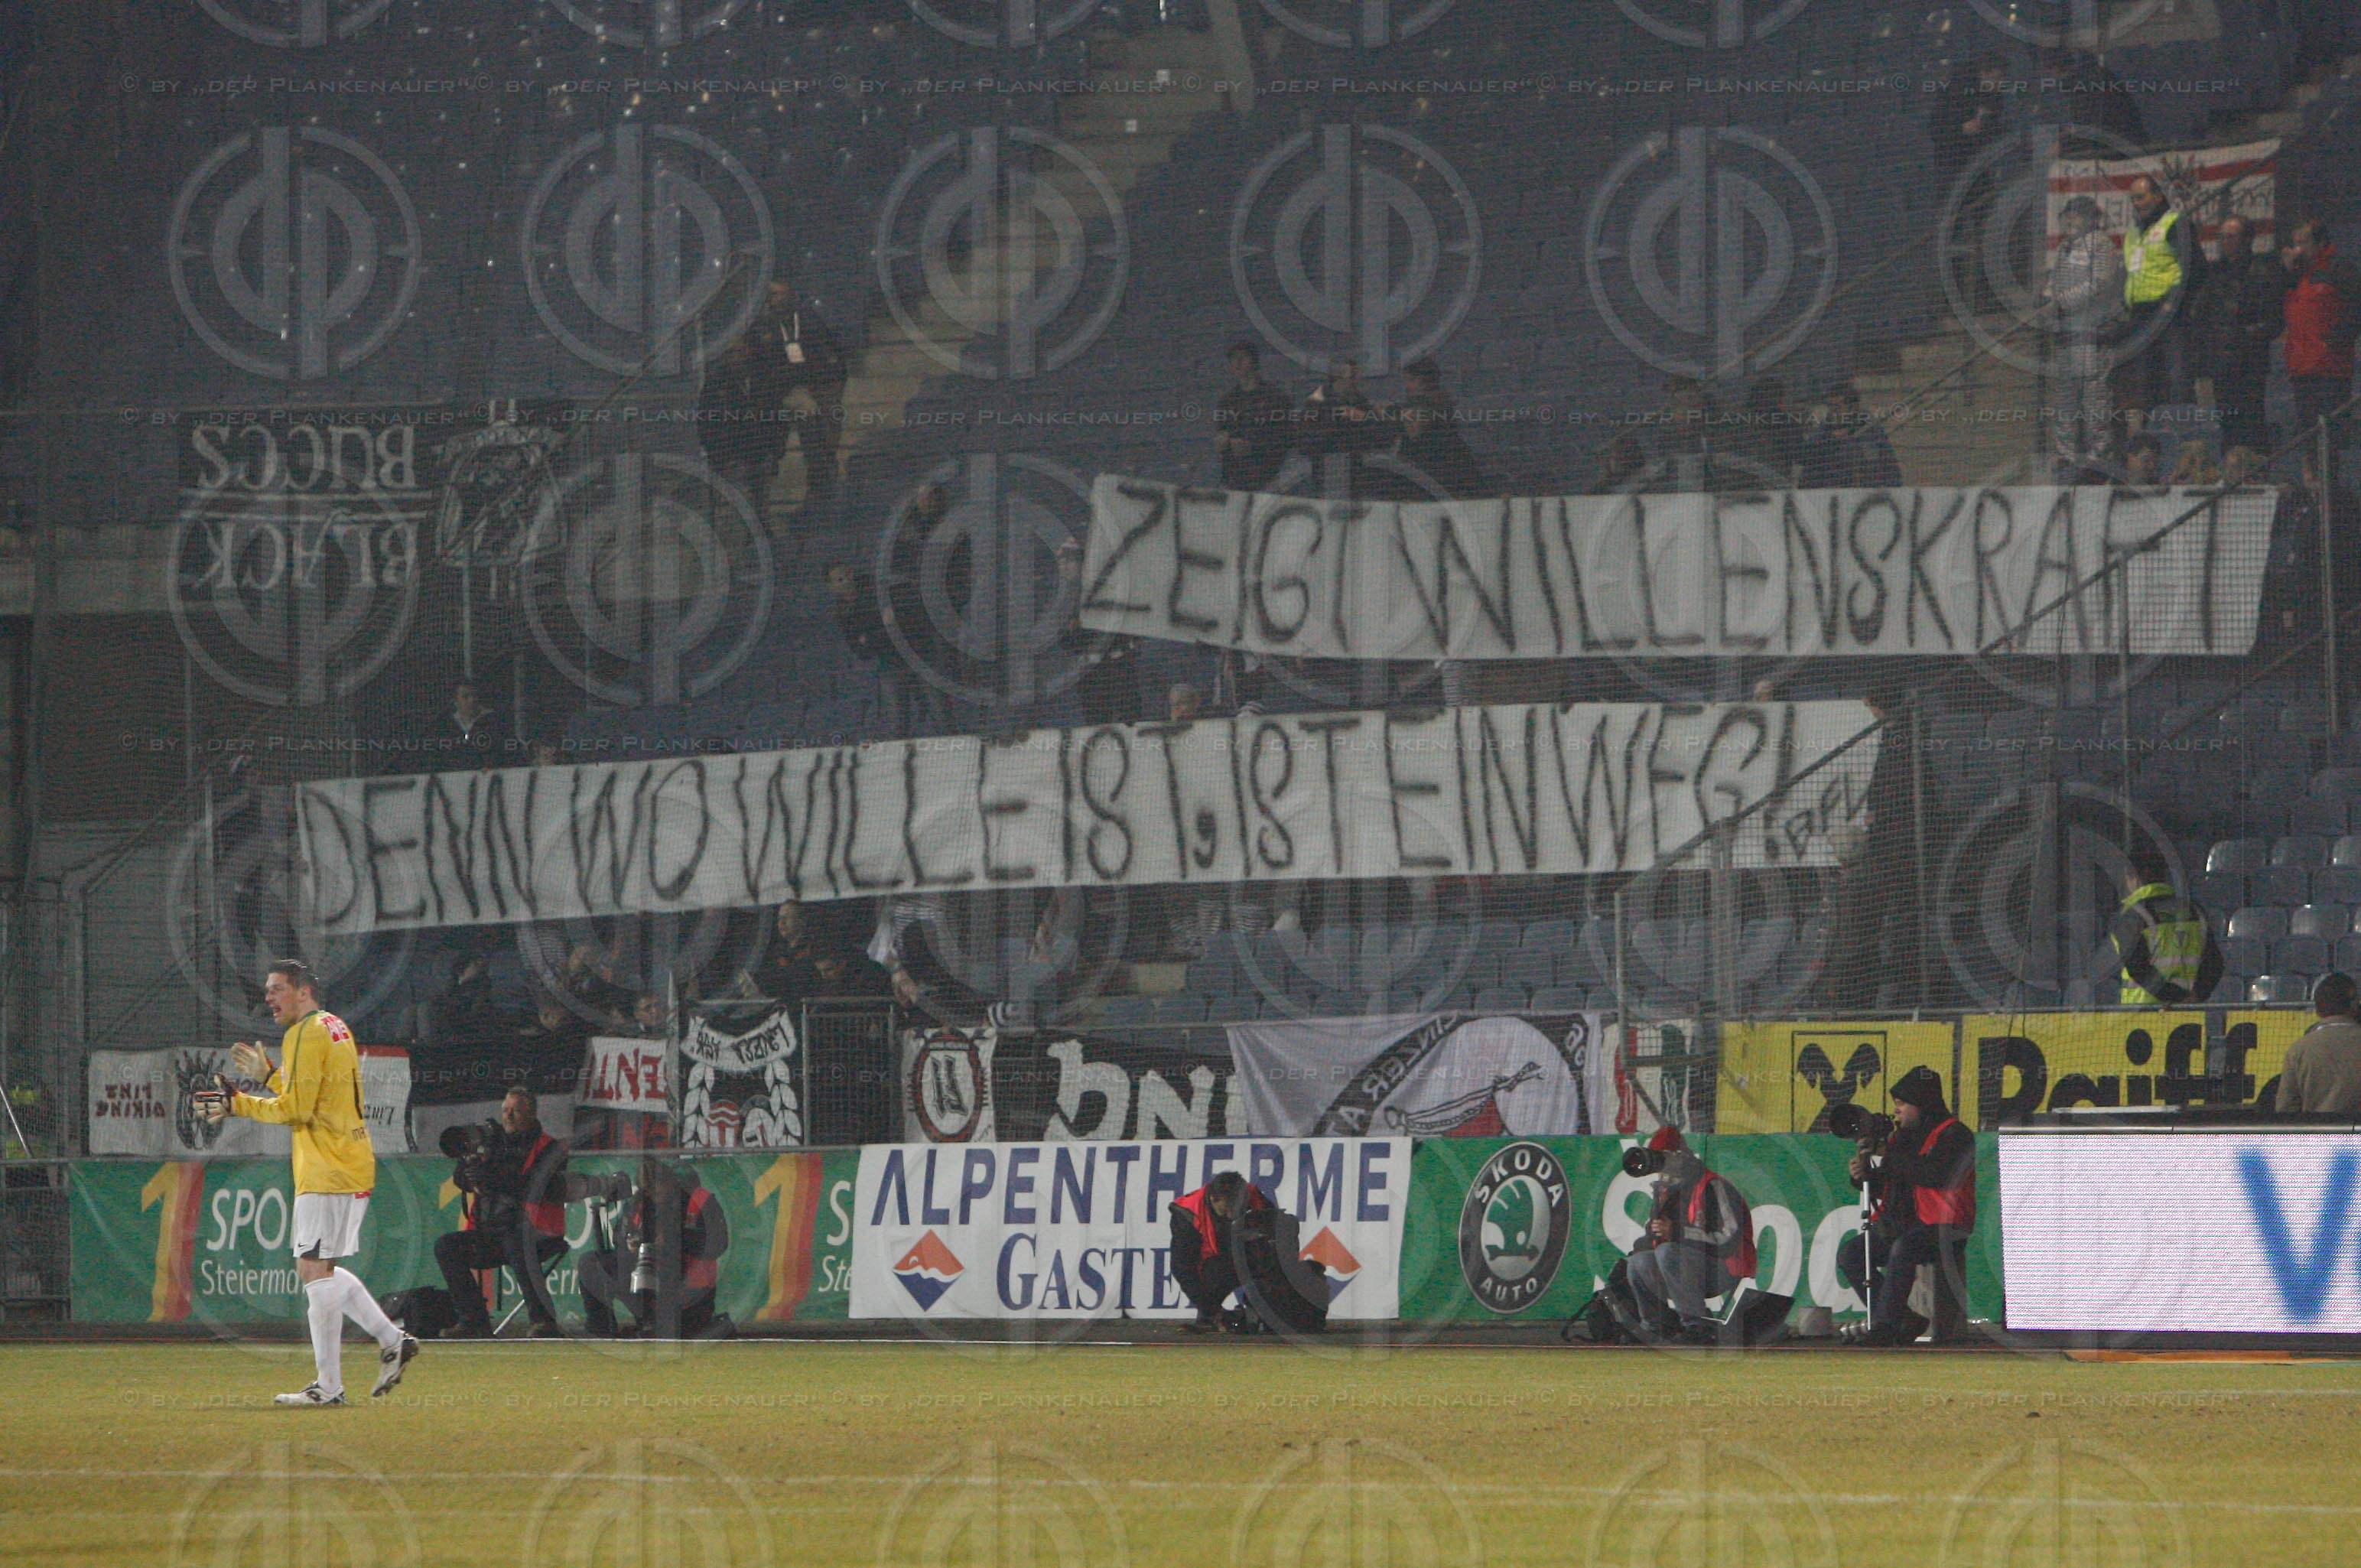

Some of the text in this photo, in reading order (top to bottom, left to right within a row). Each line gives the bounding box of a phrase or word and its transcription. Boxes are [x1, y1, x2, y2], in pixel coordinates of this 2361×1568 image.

[206, 1187, 295, 1251] SPO
[2231, 1144, 2361, 1327] V
[997, 1232, 1198, 1311] GASTE
[1480, 1277, 1538, 1302] AUTO
